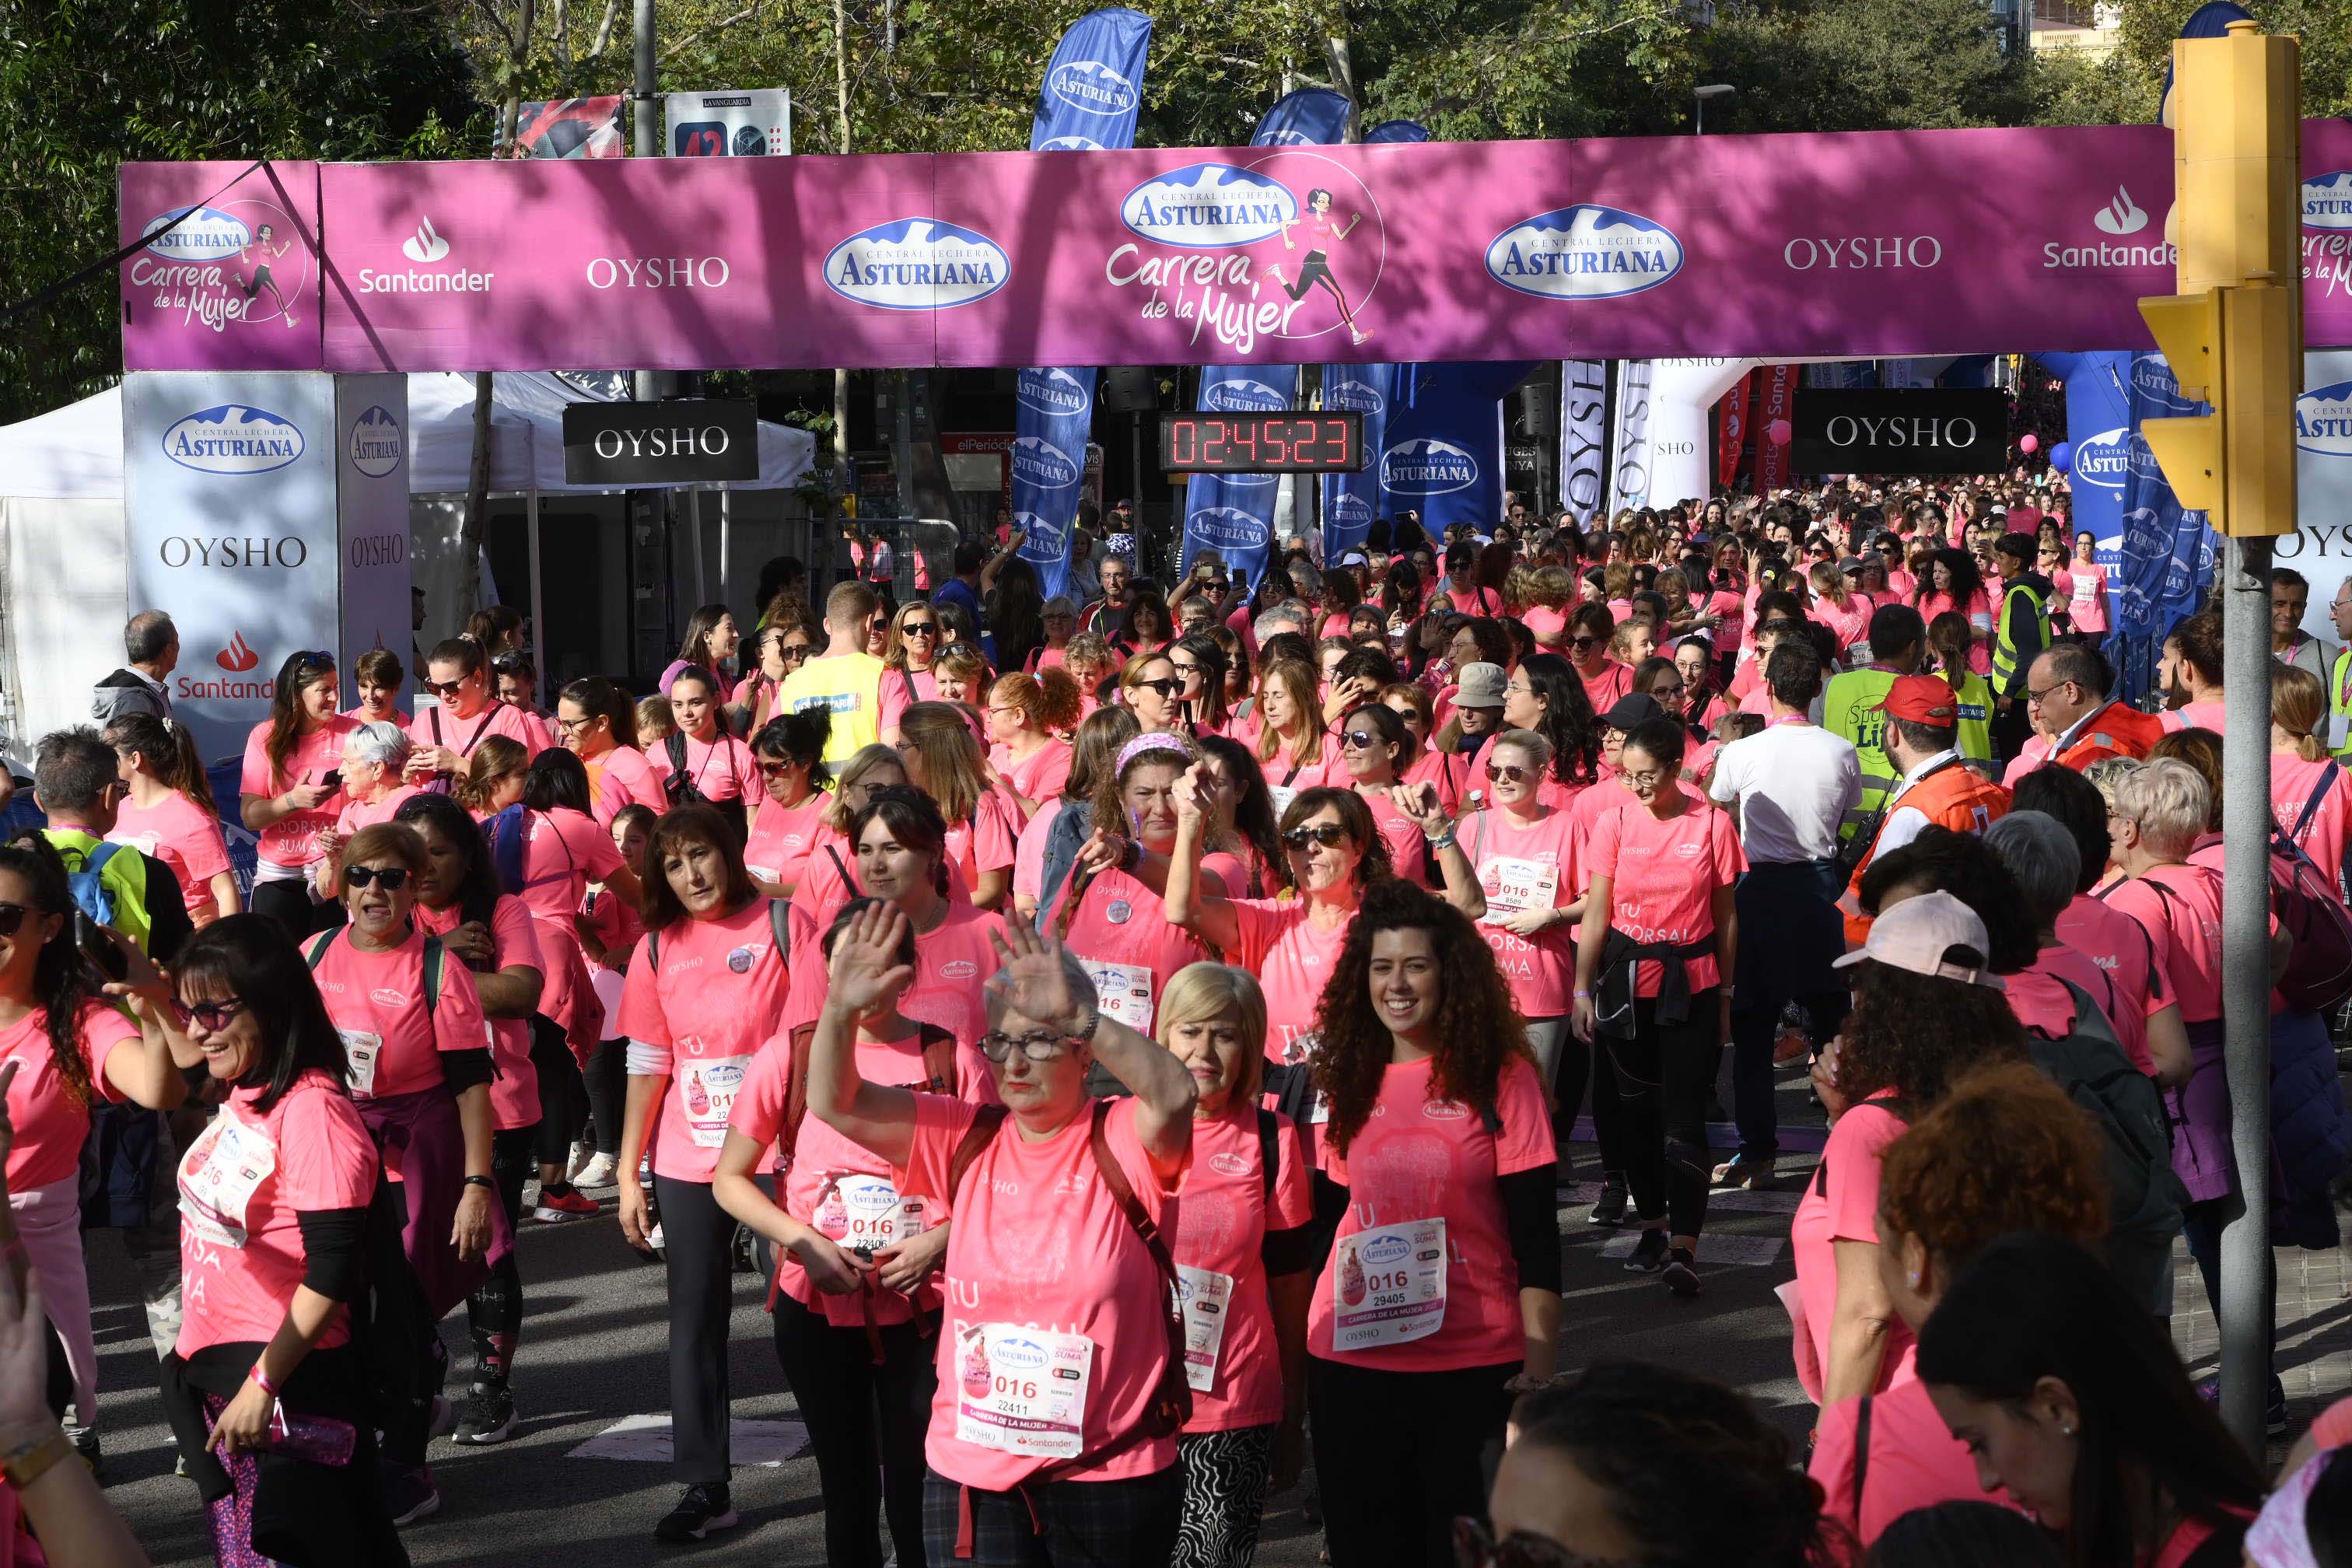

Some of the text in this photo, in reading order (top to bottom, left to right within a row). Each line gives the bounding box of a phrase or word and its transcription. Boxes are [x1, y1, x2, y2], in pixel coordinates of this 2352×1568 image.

[1056, 72, 1128, 107] ASTURIANA
[1161, 191, 1279, 201] CENTRAL LECHERA
[1135, 195, 1283, 226] ASTURIANA
[149, 226, 243, 247] ASTURIANA
[1531, 236, 1661, 247] CENTRAL LECHERA
[866, 249, 989, 259] CENTRAL LECHERA
[1500, 242, 1668, 276] ASTURIANA
[1784, 236, 1942, 270] OYSHO
[2043, 241, 2177, 268] Santande
[131, 258, 222, 286] Carrera
[586, 257, 730, 289] OYSHO
[837, 253, 996, 286] ASTURIANA
[1106, 243, 1251, 286] Carrera
[2315, 257, 2330, 279] la
[359, 268, 494, 293] Santander
[154, 286, 257, 332] de la Mujer
[1142, 282, 1306, 354] de la Mujer
[1017, 374, 1080, 409] ASTURIANA
[1767, 364, 1787, 416] Santa
[1569, 359, 1605, 510] OYSH
[1618, 359, 1650, 499] OYSH
[1827, 415, 1976, 448] OYSHO
[174, 431, 296, 457] ASTURIANA
[354, 435, 399, 460] ASTURIANA
[595, 425, 730, 458] OYSHO
[1174, 421, 1346, 464] 02:45:23
[1654, 441, 1694, 456] SHO
[1013, 456, 1069, 481] STURIANA
[1429, 457, 1467, 465] LECHERA
[1384, 464, 1471, 483] ASTURIANA
[1194, 517, 1262, 544] ASTURIANA
[160, 537, 307, 568] OYSHO
[352, 534, 403, 569] OYSHO
[178, 677, 274, 699] Santand
[278, 838, 319, 853] SUMA
[1621, 847, 1650, 856] OYSHO
[1503, 885, 1528, 898] 016
[1505, 897, 1521, 905] 8589
[1618, 902, 1640, 919] TU
[1101, 999, 1121, 1010] 16
[708, 1073, 742, 1083] ASTURIANA
[712, 1094, 737, 1106] 01
[1425, 1104, 1467, 1117] ASTURIANA
[716, 1111, 727, 1119] 22
[852, 1195, 898, 1205] ASTURIANA
[852, 1220, 893, 1234] 016
[856, 1239, 887, 1249] 22406
[1365, 1234, 1437, 1260] ASTURIANA SUMA
[948, 1276, 979, 1308] TU
[1369, 1271, 1409, 1291] 016
[1374, 1293, 1406, 1307] 29405
[1348, 1313, 1377, 1324] CARRERA
[1400, 1306, 1423, 1315] MUJER
[1346, 1328, 1379, 1342] OYSHO
[996, 1346, 1043, 1363] ASTURIANA
[1054, 1350, 1082, 1360] SUMA
[996, 1376, 1037, 1398] 016
[1187, 1371, 1205, 1381] nder
[998, 1399, 1028, 1416] 22411
[999, 1416, 1006, 1425] DE
[1020, 1421, 1048, 1430] MUJER
[1028, 1437, 1073, 1448] Santander
